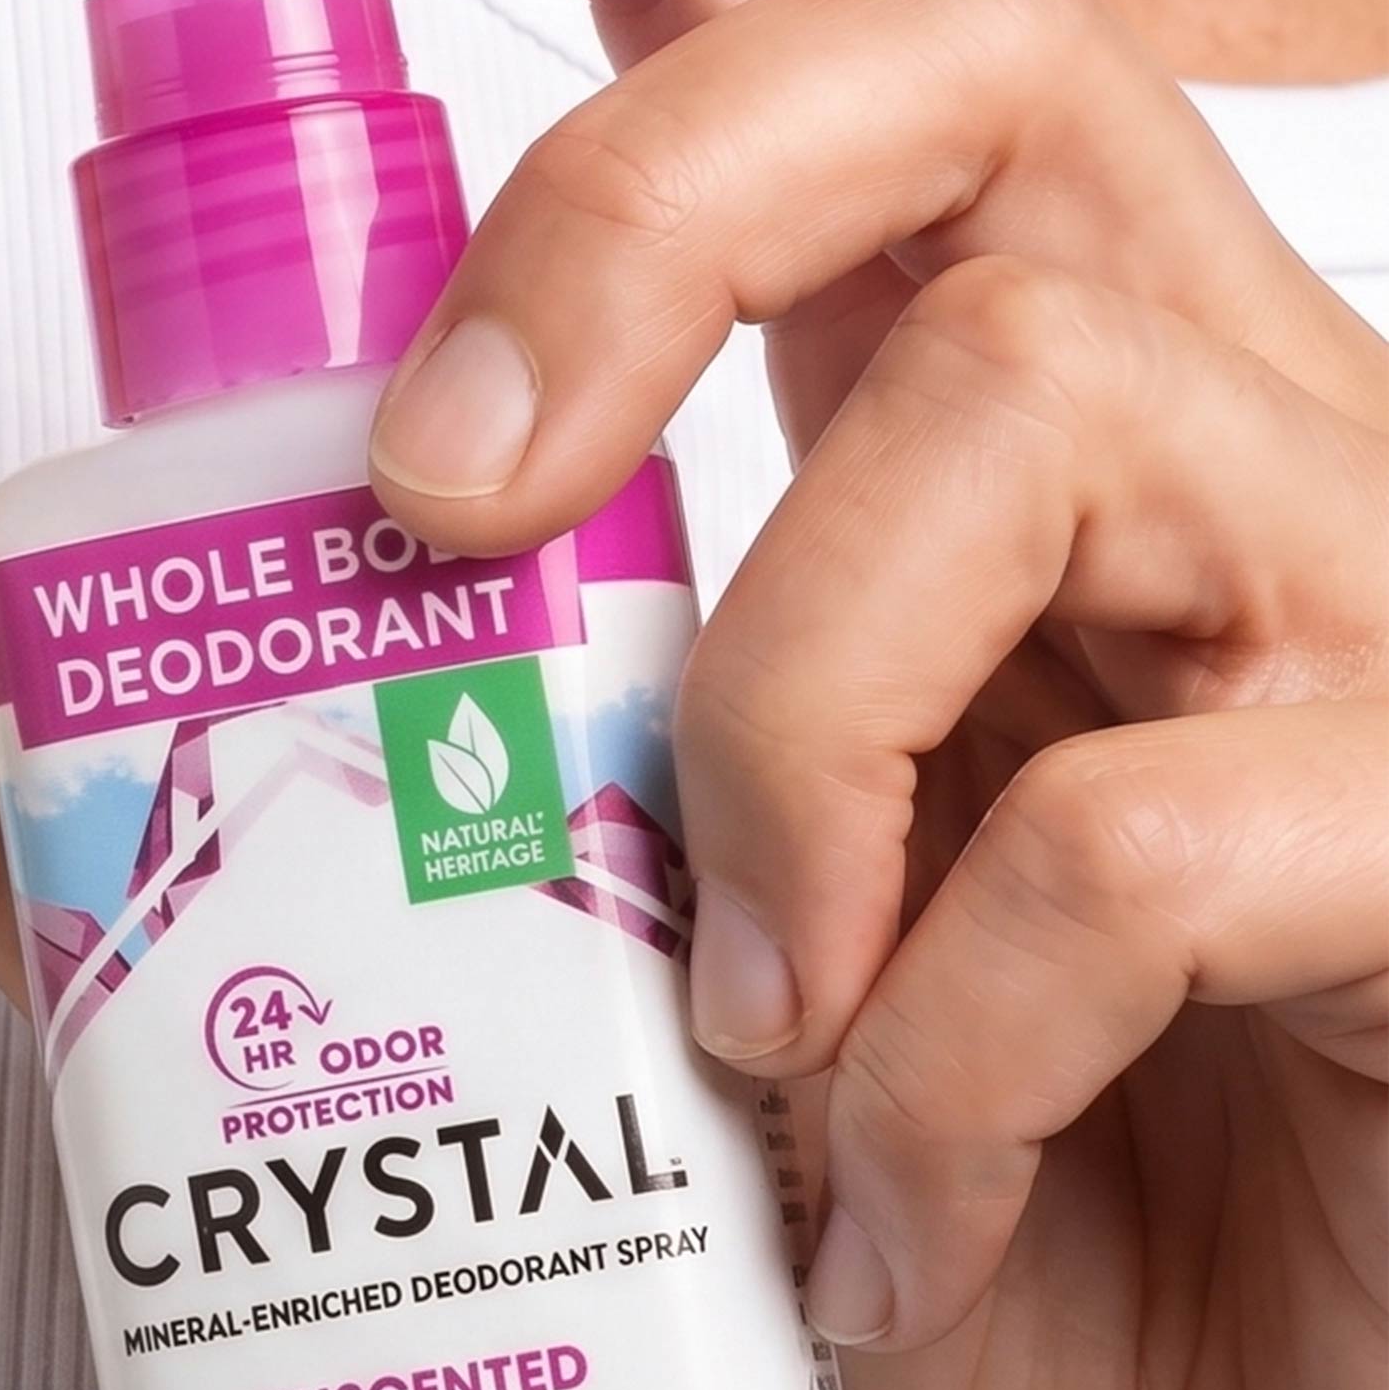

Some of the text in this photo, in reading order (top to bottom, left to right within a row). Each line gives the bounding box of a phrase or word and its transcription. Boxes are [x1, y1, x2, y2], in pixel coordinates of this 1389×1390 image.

[36, 518, 460, 637] WHOLE BO
[59, 578, 512, 715] DEODORANT
[425, 840, 545, 881] HERITAGE
[229, 990, 293, 1039] 24
[244, 1040, 295, 1073] HR
[321, 1027, 444, 1074] ODOR
[222, 1075, 454, 1144] PROTECTION
[105, 1094, 688, 1287] CRYSTAL
[124, 1227, 707, 1356] MINERAL-ENRICHED DEODORANT SPRAY
